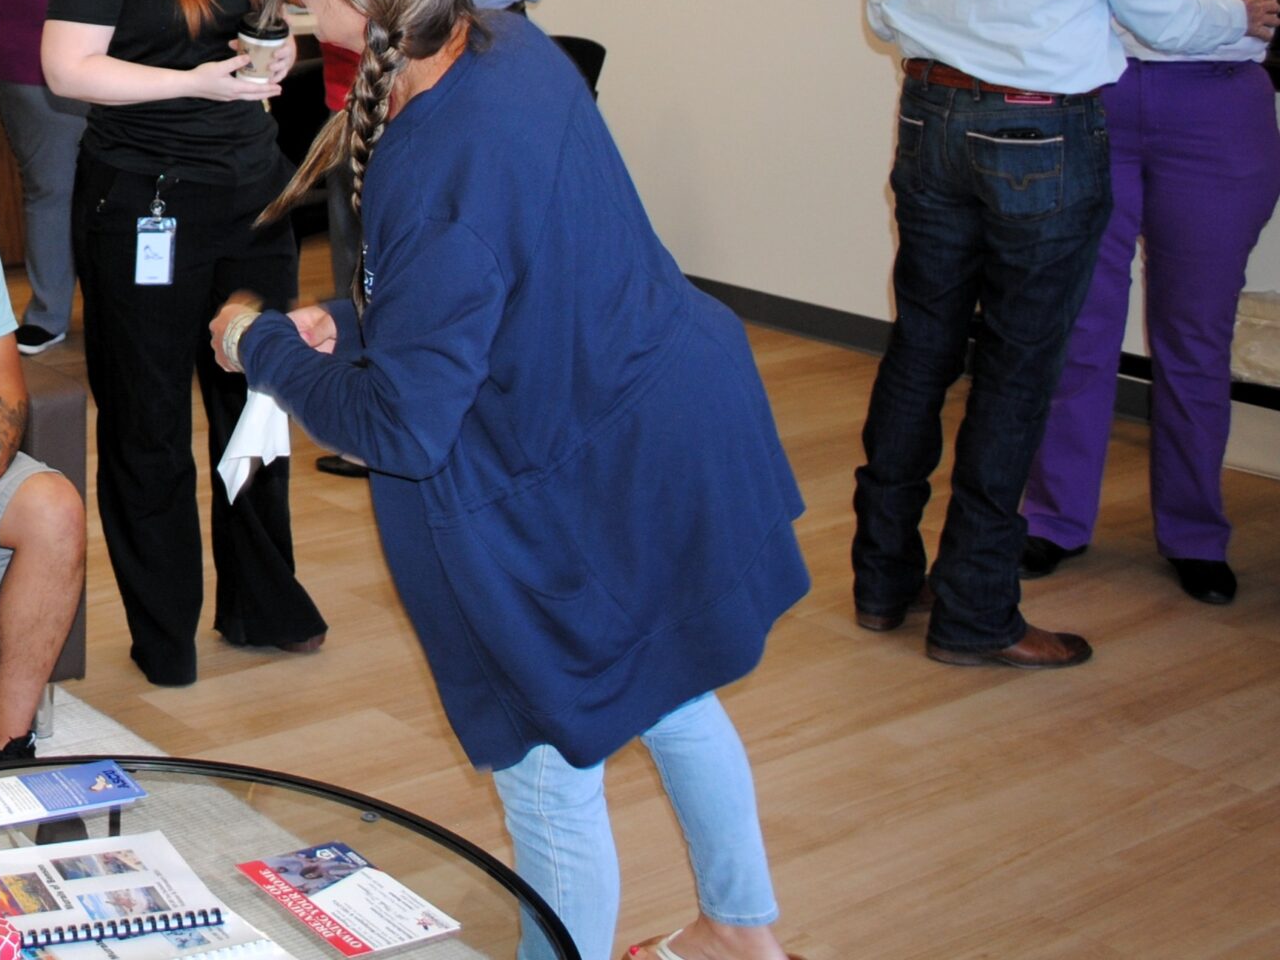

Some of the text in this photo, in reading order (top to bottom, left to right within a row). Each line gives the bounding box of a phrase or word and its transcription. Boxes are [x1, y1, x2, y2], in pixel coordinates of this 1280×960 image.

[259, 868, 292, 893] HOME
[262, 883, 284, 898] OF
[287, 891, 321, 915] YOUR
[278, 893, 334, 939] DREAMING
[317, 913, 364, 950] OWNING
